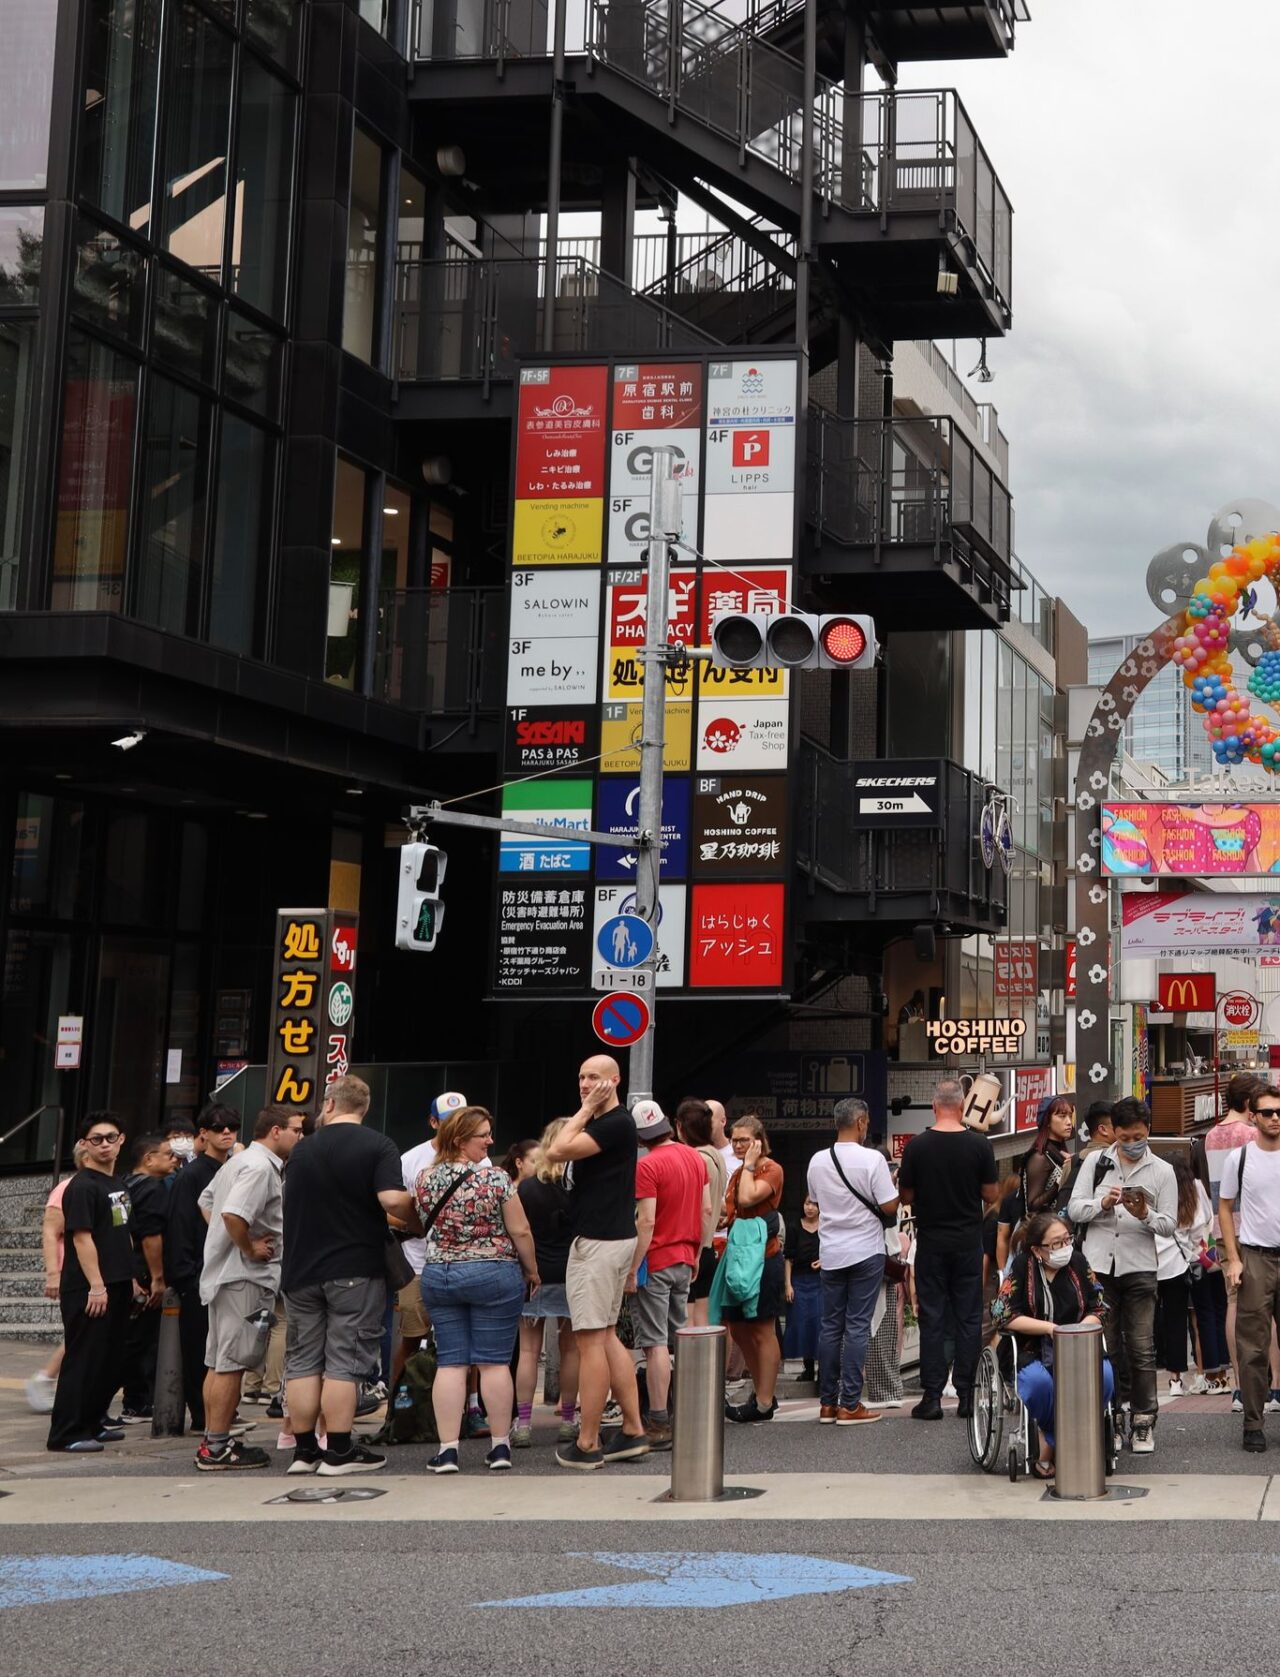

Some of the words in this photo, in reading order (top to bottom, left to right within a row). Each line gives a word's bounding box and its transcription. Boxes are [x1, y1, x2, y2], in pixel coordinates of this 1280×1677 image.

[618, 367, 634, 379] 7F
[711, 365, 728, 376] 7F
[623, 381, 693, 397] 原宿駅前
[642, 405, 674, 419] 歯科
[615, 432, 634, 446] 6F
[709, 430, 728, 443] 4F
[731, 473, 769, 483] LIPPS
[531, 503, 558, 511] Vending
[612, 499, 632, 512] 5F
[514, 573, 534, 586] 3F
[609, 571, 640, 584] 1F/2F
[524, 598, 589, 609] SALOWIN
[616, 624, 694, 638] PHAACY
[511, 641, 531, 654] 3F
[521, 666, 546, 677] me
[551, 660, 572, 681] by
[511, 709, 527, 721] 1F
[606, 706, 623, 719] 1F
[753, 719, 783, 730] Japan
[749, 730, 785, 740] Tax-free
[762, 741, 785, 751] Shop
[522, 749, 544, 759] PAS
[556, 748, 579, 759] PAS
[700, 779, 716, 792] BF
[855, 776, 937, 787] SKECHERS
[716, 790, 742, 804] HAND
[745, 790, 767, 802] DRIP
[877, 801, 904, 811] 30m
[1114, 809, 1147, 821] FASHION
[704, 828, 742, 836] HOSHINO
[745, 827, 777, 835] COFFEE
[1162, 829, 1195, 841] FASHION
[700, 840, 780, 861] 星乃珈琲
[1162, 849, 1195, 862] FASHION
[519, 853, 535, 871] 酒
[540, 854, 571, 869] たばこ
[502, 890, 585, 904] 防災備蓄倉庫
[598, 889, 617, 901] BF
[501, 920, 534, 932] Emergency
[536, 920, 568, 930] Evacuation
[569, 920, 583, 930] Area
[702, 914, 772, 929] はらじゅく
[332, 928, 355, 970] くすり
[700, 938, 772, 956] アッシュ
[276, 923, 320, 1102] 処方せん
[1226, 1004, 1250, 1016] 消火栓
[926, 1019, 1027, 1037] HOSHINO
[934, 1036, 1019, 1054] COFFEE
